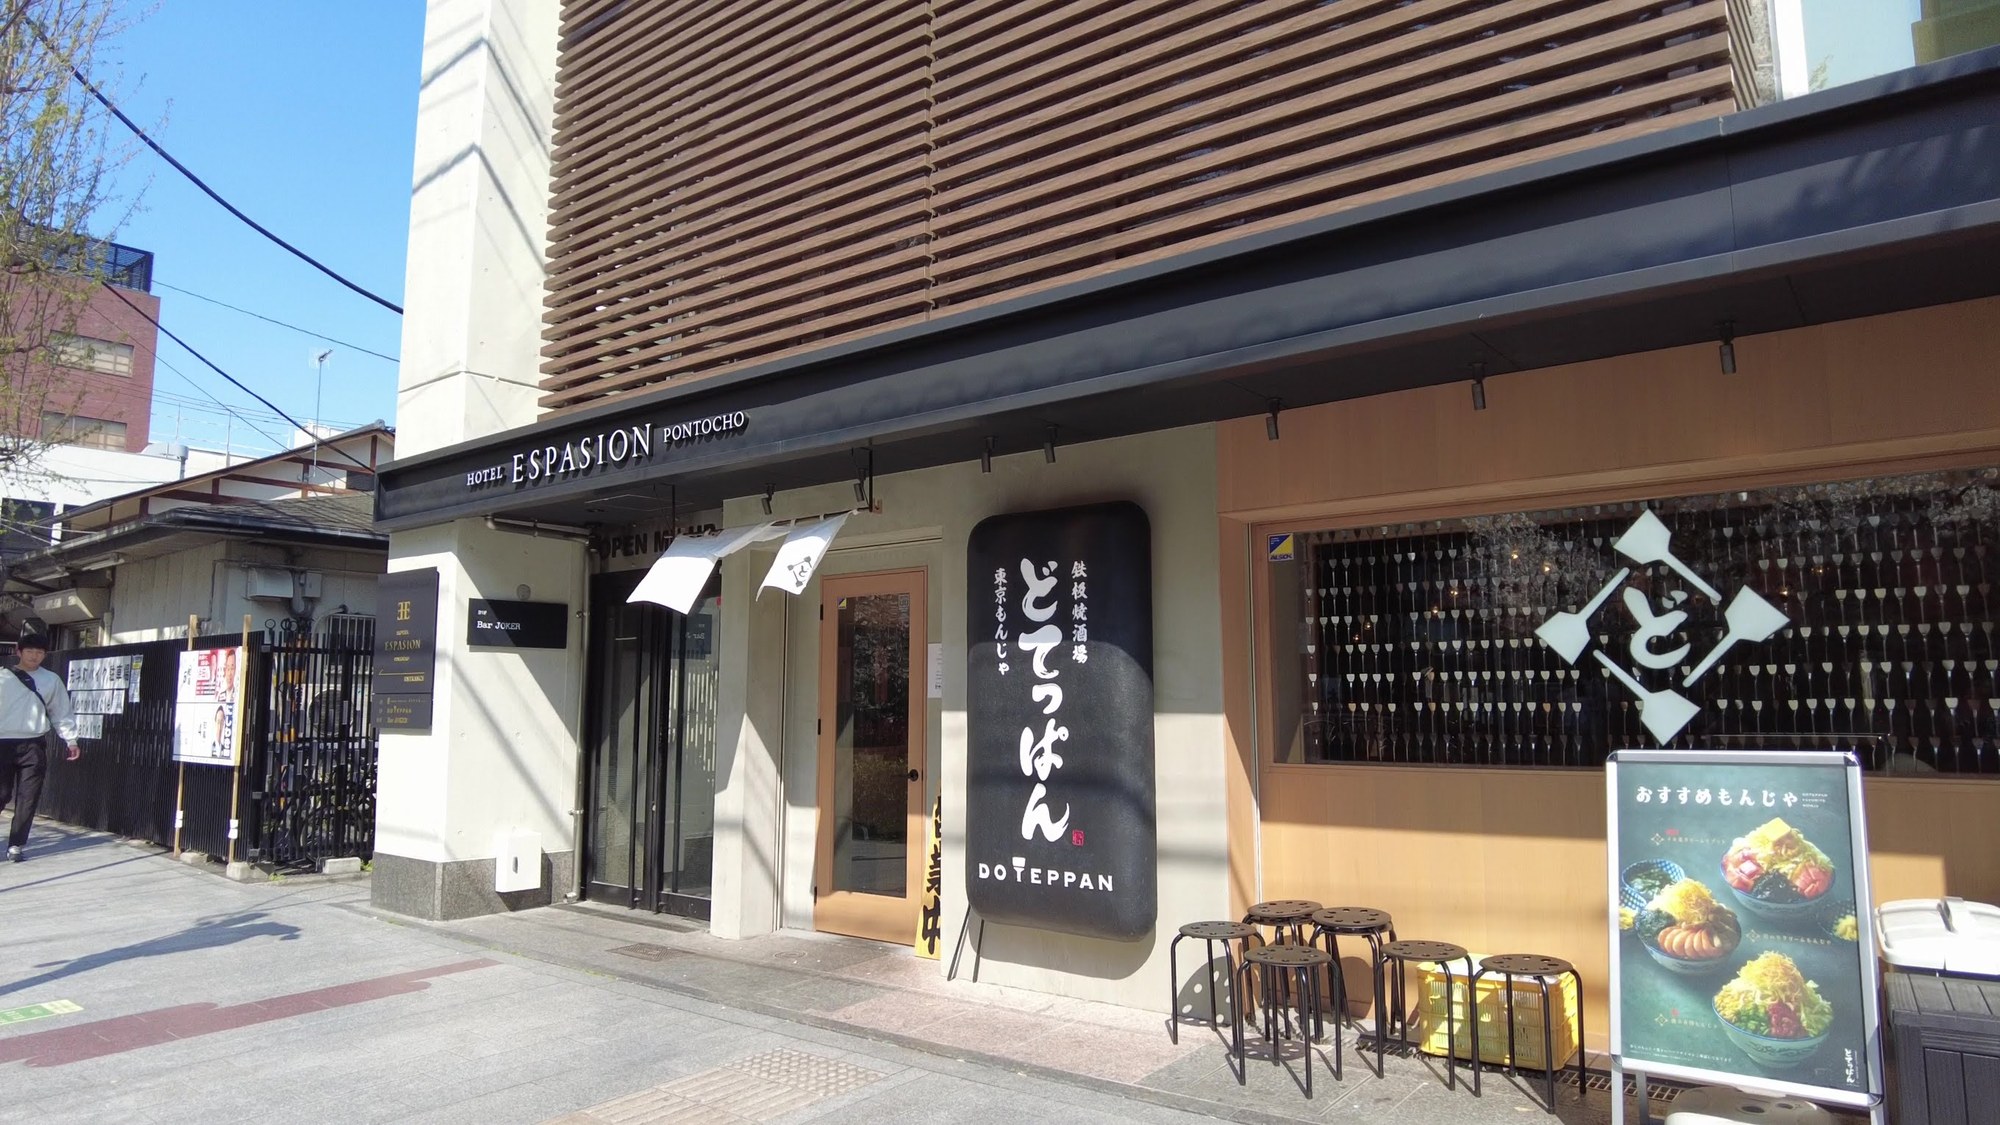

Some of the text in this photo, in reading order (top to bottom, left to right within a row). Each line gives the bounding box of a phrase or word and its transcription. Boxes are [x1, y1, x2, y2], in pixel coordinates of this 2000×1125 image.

[466, 411, 745, 486] HOTEL ESPASION PONTOCHO
[384, 639, 421, 651] ESPASION
[476, 620, 521, 630] Bar JOKER
[994, 567, 1010, 675] 東京もんじゃ
[1071, 560, 1088, 664] 鉄板焼酒場
[1623, 586, 1691, 669] ど
[1018, 557, 1069, 842] どてっぱん
[1636, 786, 1799, 808] おすすめもんじゃ
[978, 856, 1113, 892] DOTEPPAN
